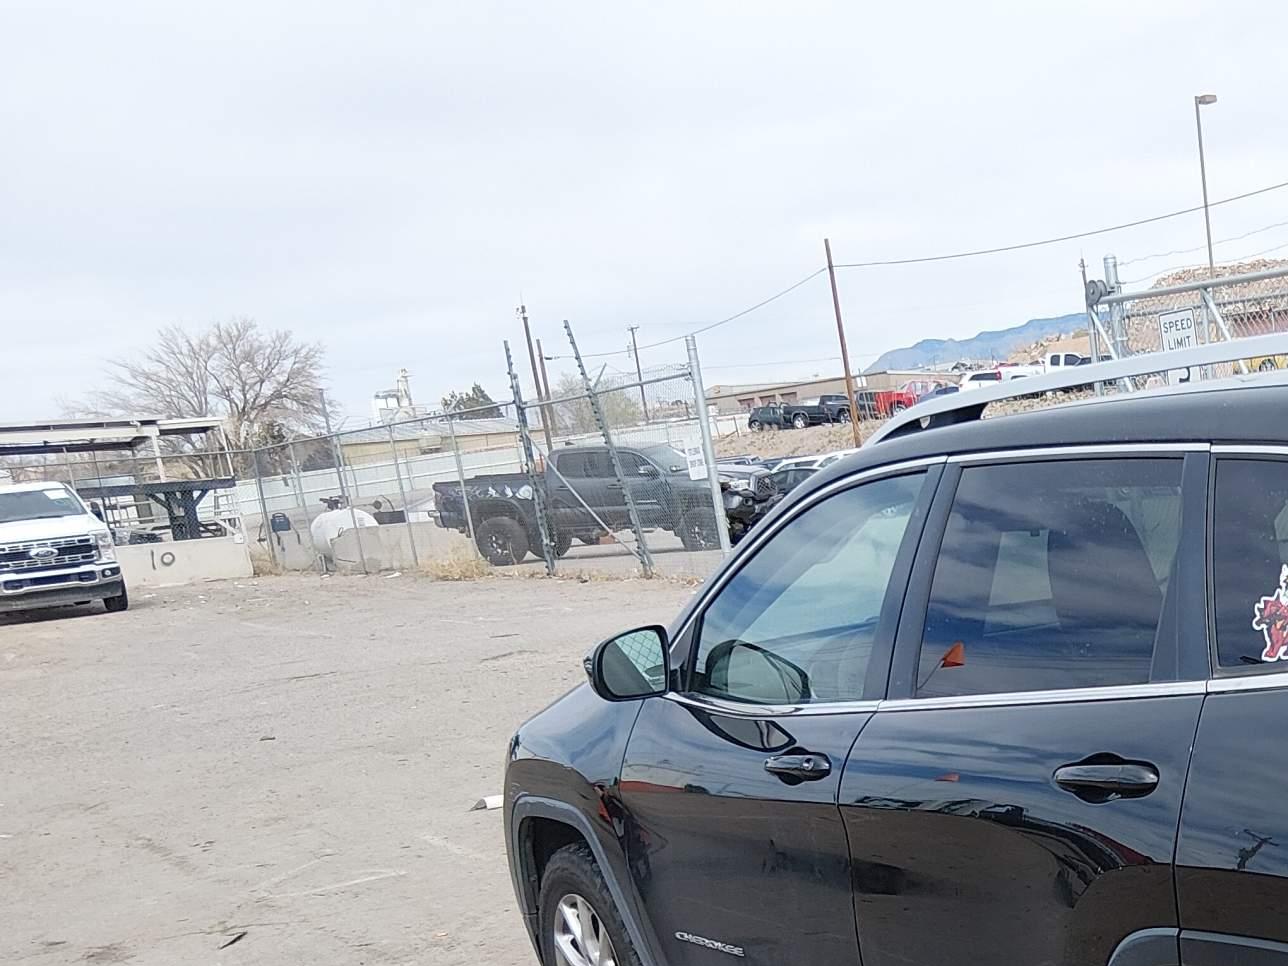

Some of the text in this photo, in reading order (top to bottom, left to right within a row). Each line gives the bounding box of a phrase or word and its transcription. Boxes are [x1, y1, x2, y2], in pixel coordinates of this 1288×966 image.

[1162, 318, 1193, 334] SPEED
[1167, 335, 1191, 350] LIMIT
[674, 931, 745, 957] CHEROKEE
